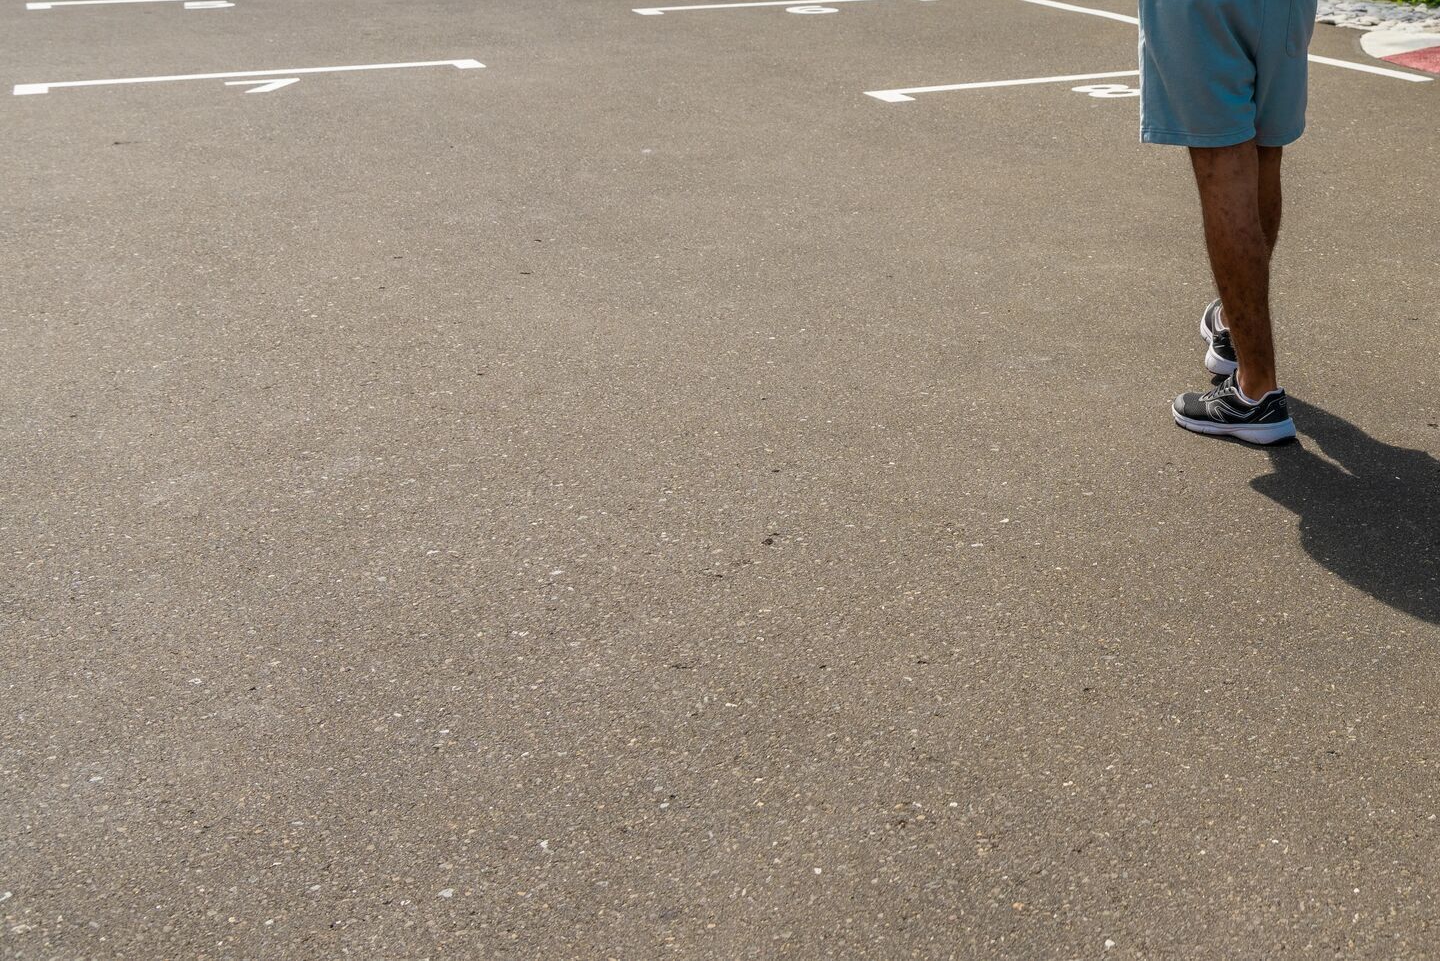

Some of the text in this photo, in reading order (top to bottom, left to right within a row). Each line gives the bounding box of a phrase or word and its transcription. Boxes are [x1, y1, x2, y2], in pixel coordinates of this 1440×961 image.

[785, 5, 839, 14] 6
[224, 77, 300, 93] 7
[1071, 84, 1140, 98] 8
